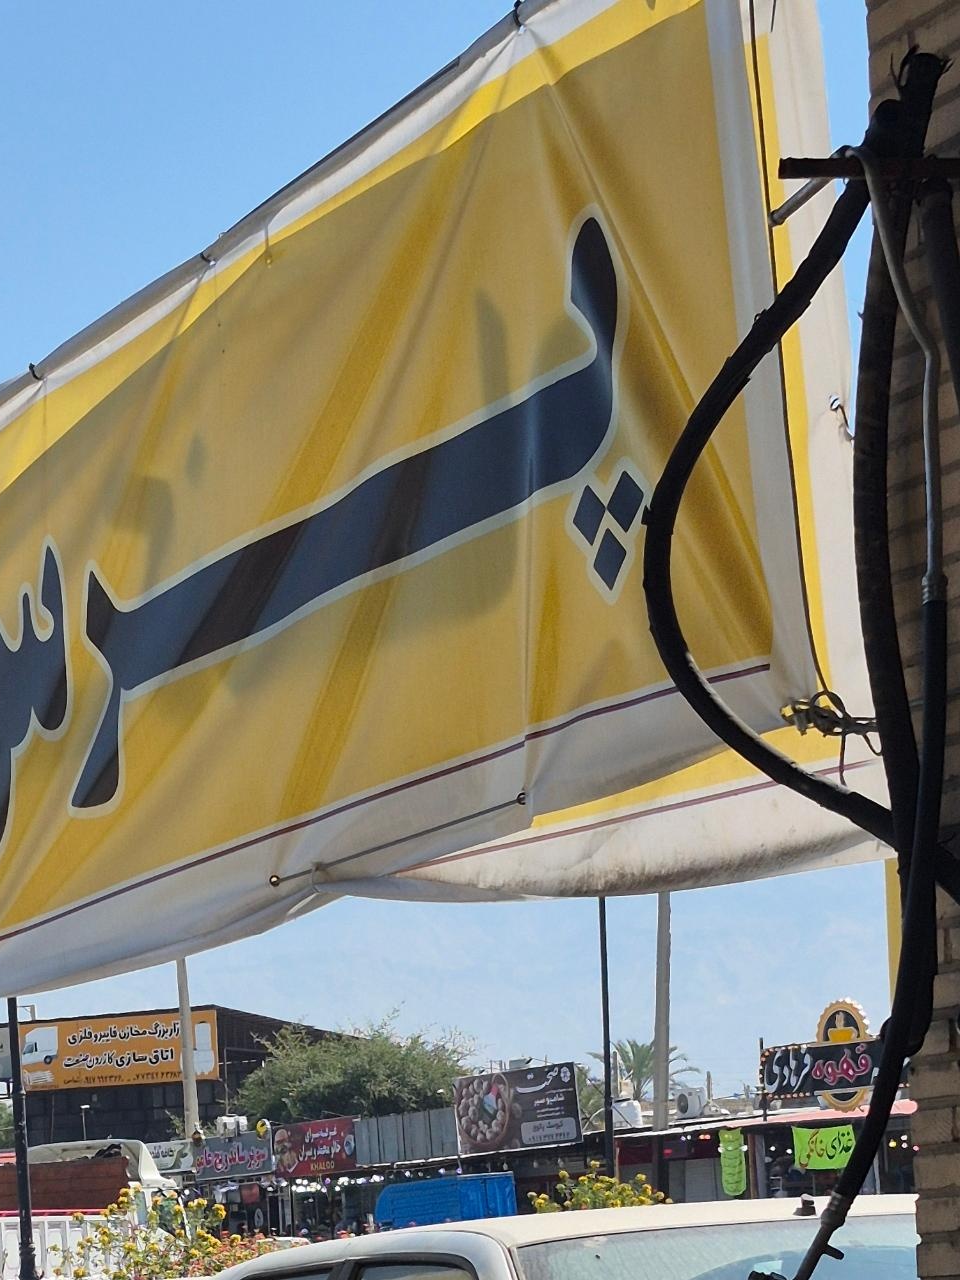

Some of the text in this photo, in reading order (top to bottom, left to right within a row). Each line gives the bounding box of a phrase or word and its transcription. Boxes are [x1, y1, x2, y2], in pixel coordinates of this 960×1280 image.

[67, 1026, 93, 1046] فلزی
[98, 1025, 119, 1043] فایبر
[119, 1023, 148, 1040] مخازن
[149, 1021, 169, 1040] بزرگ
[63, 1048, 174, 1069] اتاق سازی کازرون صنعت
[812, 1043, 872, 1086] قهوه
[799, 1129, 853, 1168] غذای خانگی
